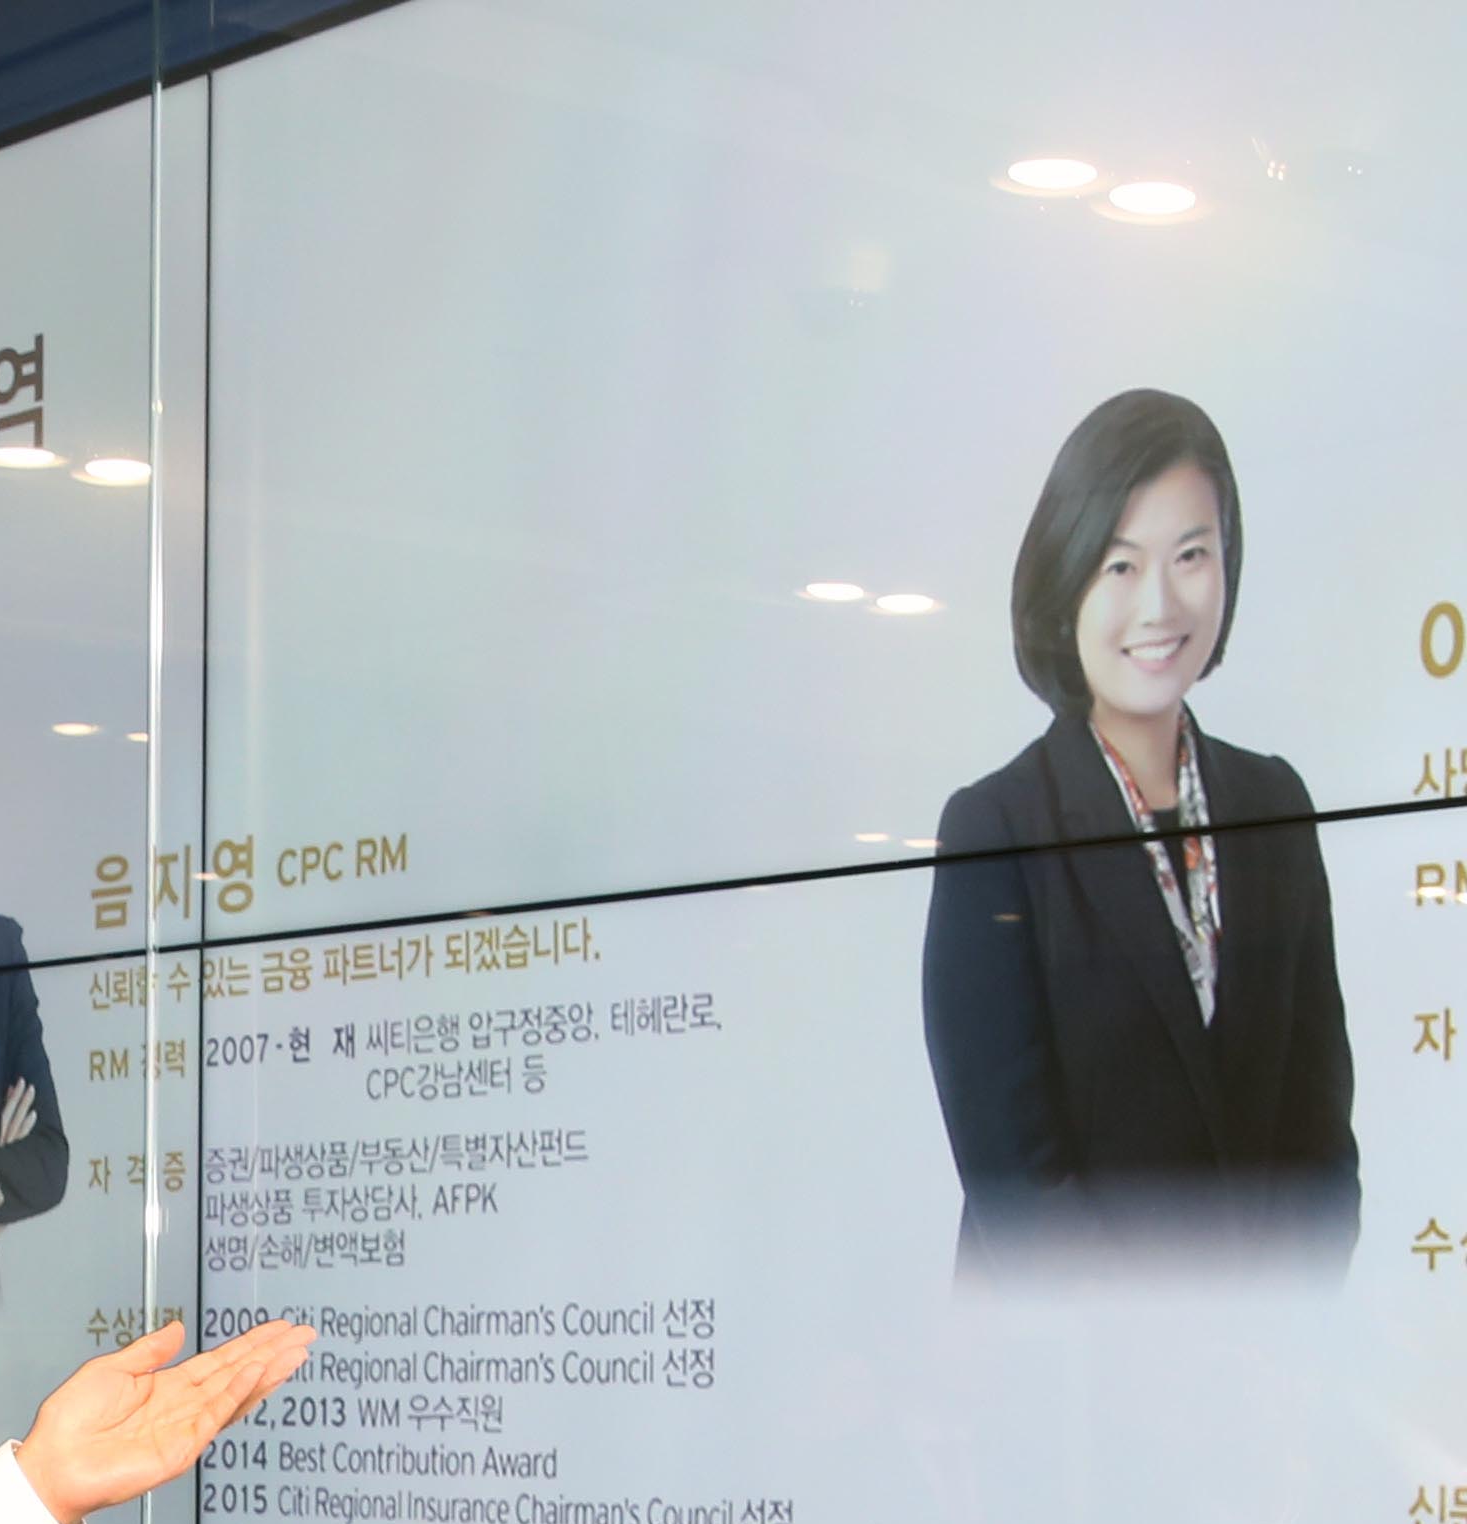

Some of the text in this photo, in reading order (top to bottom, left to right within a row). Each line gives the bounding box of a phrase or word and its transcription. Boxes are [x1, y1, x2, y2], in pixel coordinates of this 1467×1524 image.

[277, 842, 343, 887] CPC
[356, 833, 408, 878] RM
[167, 962, 191, 1002] 수
[203, 956, 251, 998] 있는
[261, 947, 313, 993] 금융
[323, 934, 435, 985] 파트너가
[444, 917, 601, 974] 되겠습니다.
[90, 1047, 129, 1082] RM
[366, 1014, 461, 1056] 씨티은행
[366, 1055, 548, 1101] CPC강남센터 등
[204, 1188, 293, 1227] 파생상품
[432, 1182, 499, 1215] AFPK
[321, 1304, 417, 1345] Regional
[423, 1302, 556, 1338] Chairman's
[562, 1300, 655, 1337] Council
[663, 1298, 716, 1341] 선정
[321, 1350, 417, 1391] Regional
[423, 1350, 556, 1386] Chairman's
[562, 1349, 655, 1386] Council
[663, 1346, 716, 1390] 선정
[359, 1397, 401, 1428] WM
[407, 1393, 504, 1434] 우수직원
[203, 1439, 558, 1480] 2014 Best Contribution Award
[203, 1483, 268, 1514] 2015
[278, 1485, 310, 1518] Citi
